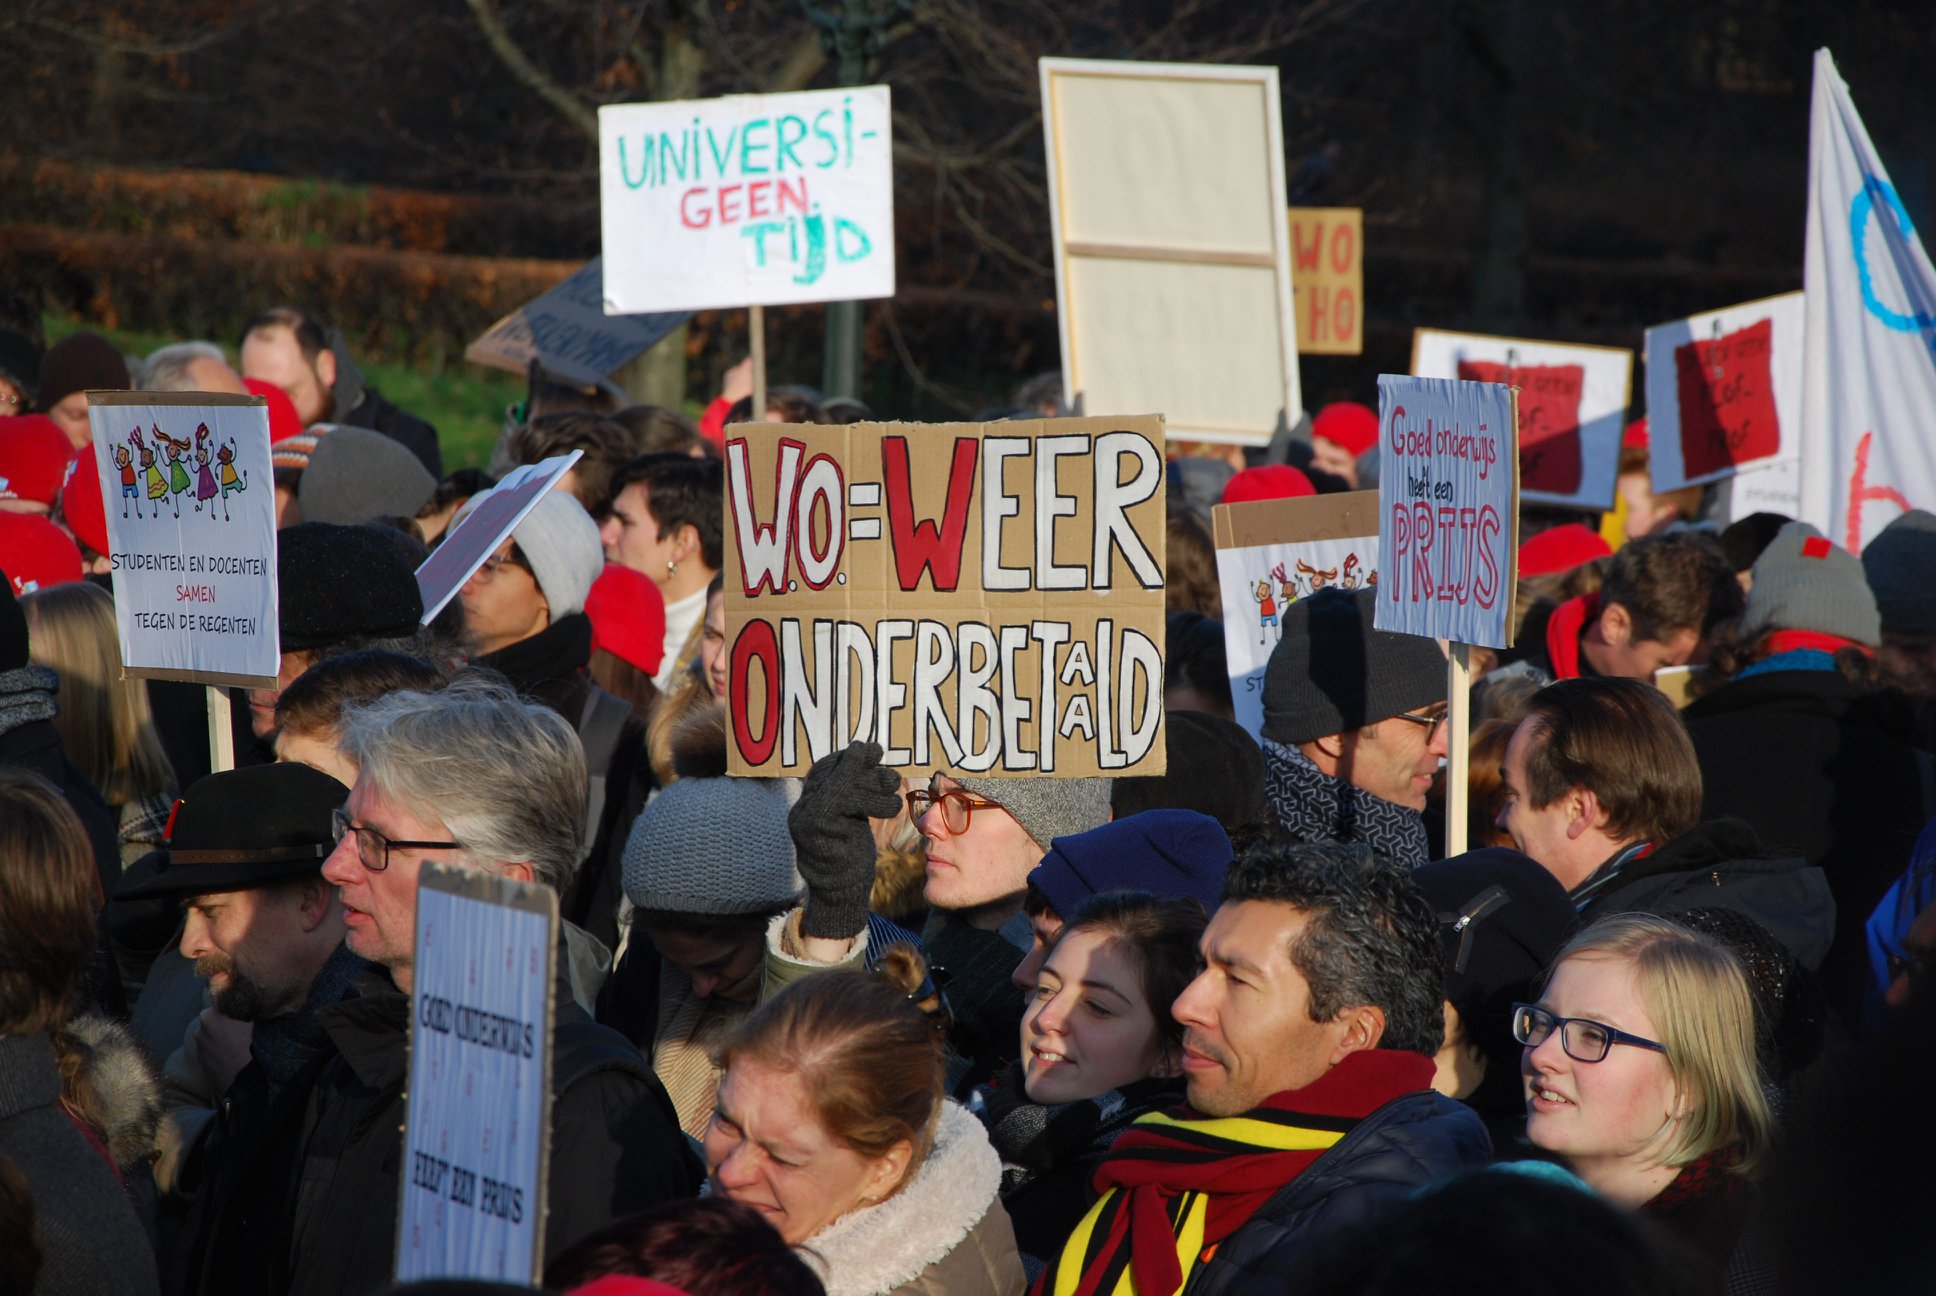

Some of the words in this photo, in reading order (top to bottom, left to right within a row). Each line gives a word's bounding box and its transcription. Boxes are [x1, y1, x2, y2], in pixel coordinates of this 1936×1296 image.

[680, 177, 809, 230] GEEN
[1391, 405, 1432, 457] Goed
[1436, 422, 1496, 481] onderwijs
[1408, 466, 1431, 500] heeft
[1434, 480, 1454, 503] een
[110, 553, 185, 573] STUDENTEN
[189, 555, 205, 573] EN
[208, 556, 267, 576] DOCENTEN
[1392, 501, 1500, 610] PRIJS
[176, 584, 216, 603] SAMEN
[134, 612, 175, 631] TEGEN
[179, 613, 196, 631] DE
[199, 615, 256, 636] REGENTEN
[729, 617, 1163, 773] ONDERBETAALD
